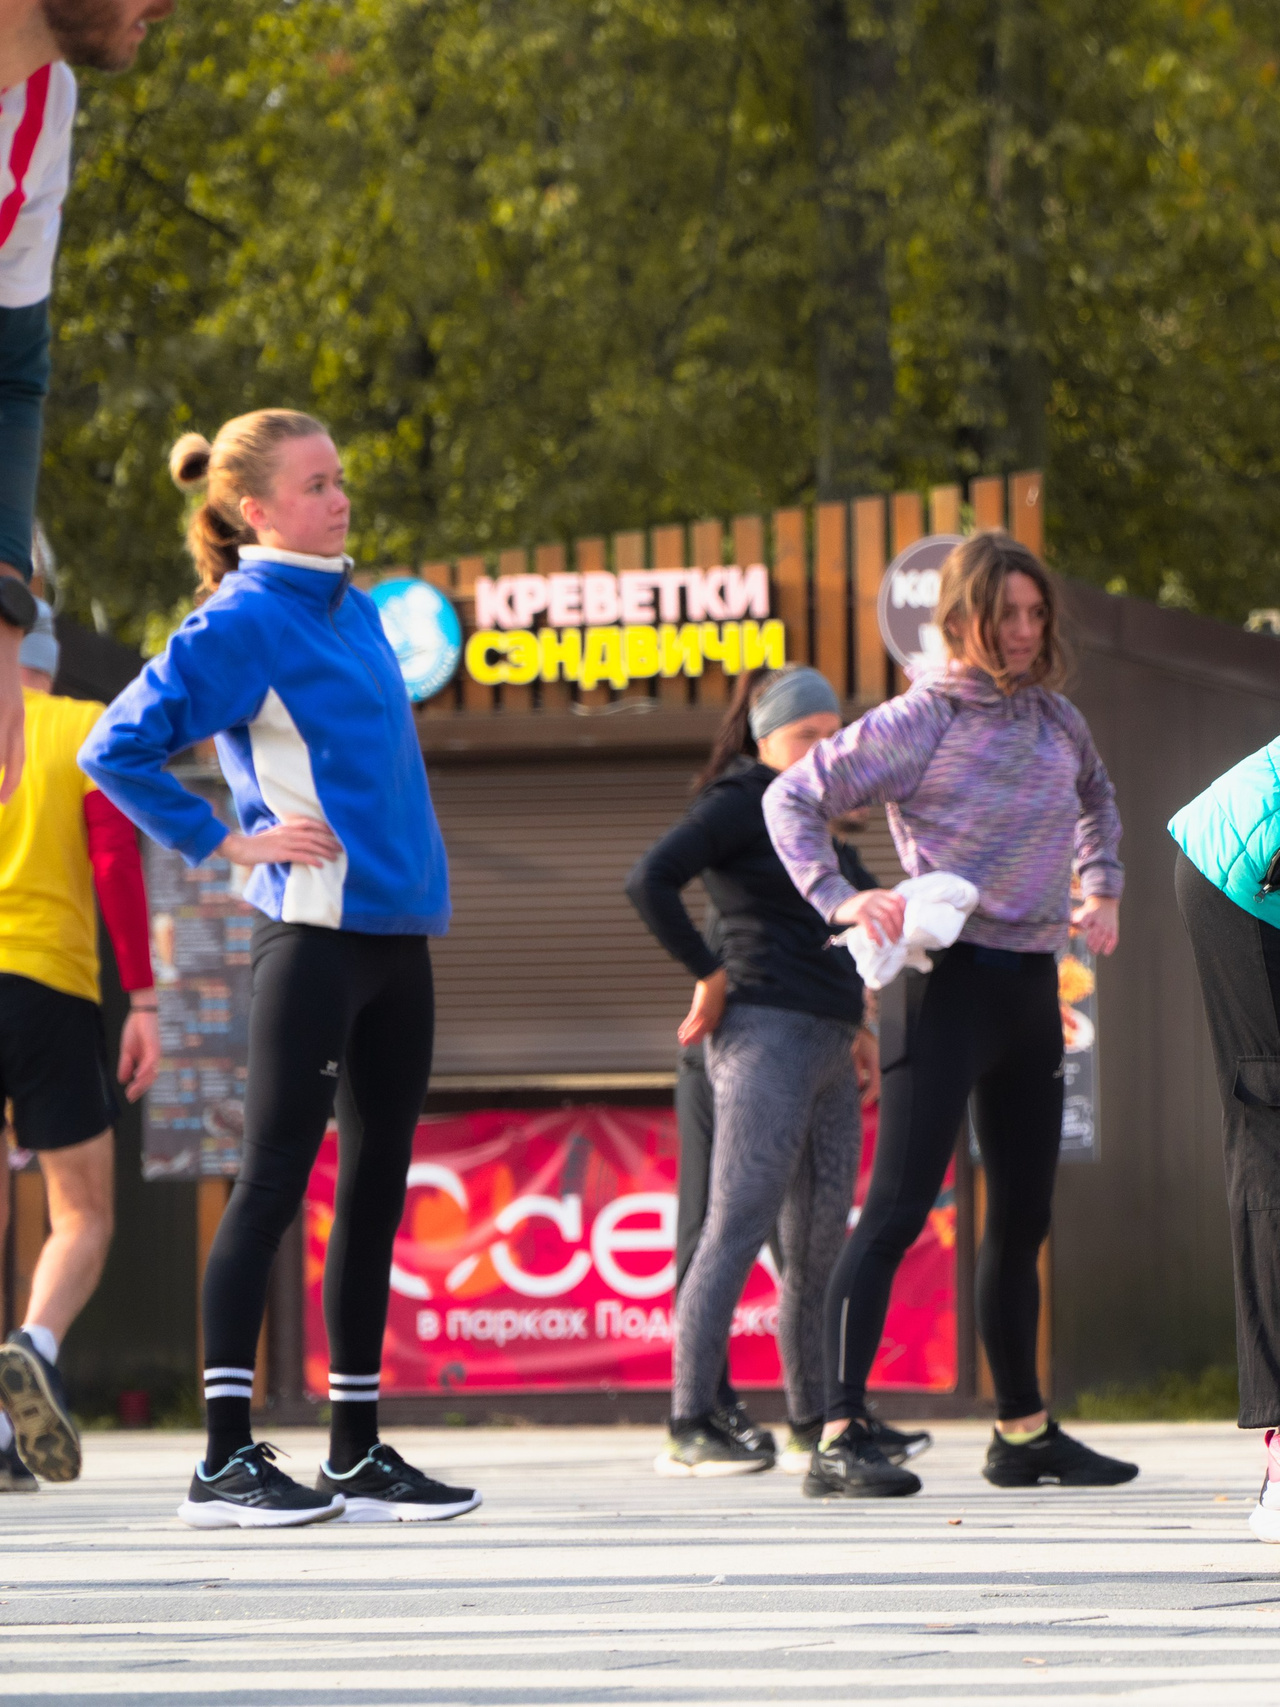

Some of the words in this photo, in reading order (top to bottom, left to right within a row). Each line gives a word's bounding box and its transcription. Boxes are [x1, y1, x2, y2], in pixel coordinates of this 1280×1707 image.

[475, 563, 770, 630] КРЕВЕТКИ
[465, 619, 786, 691] СЭНДВИЧИ
[416, 1308, 441, 1341] в
[446, 1308, 589, 1348] парках
